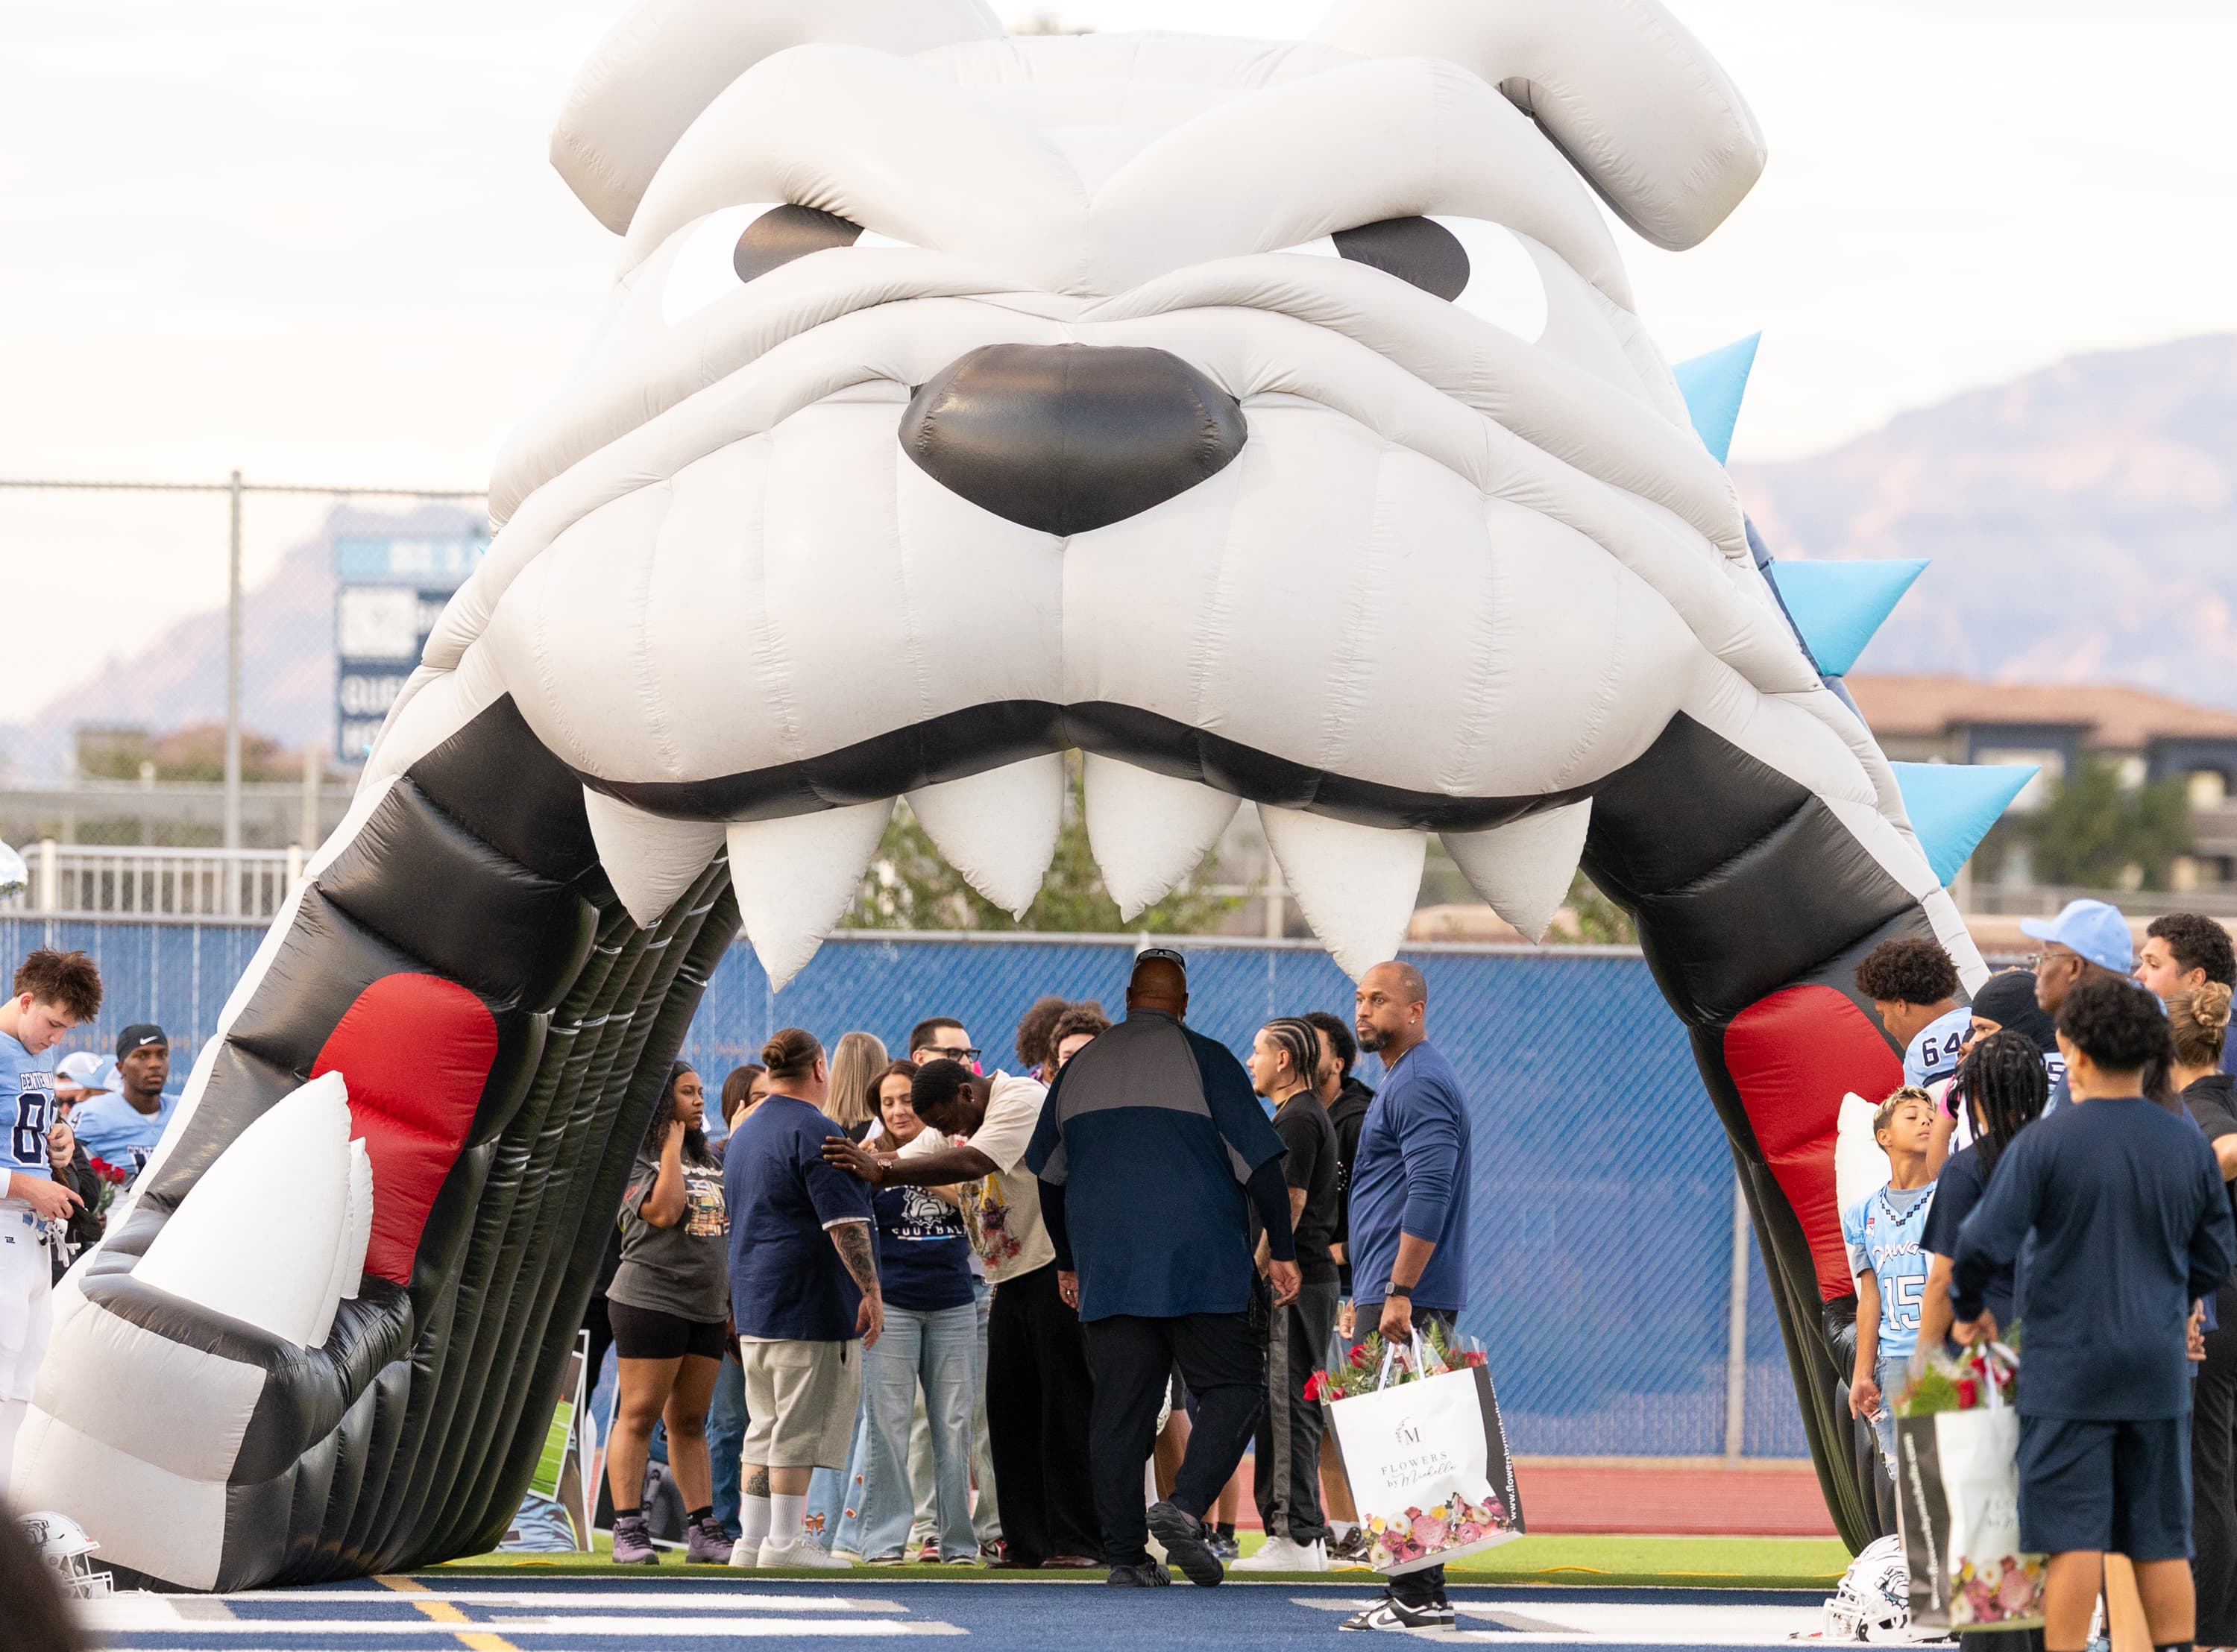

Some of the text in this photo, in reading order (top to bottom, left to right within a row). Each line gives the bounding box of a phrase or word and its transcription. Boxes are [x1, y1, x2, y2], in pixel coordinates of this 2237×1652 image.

[1922, 1031, 1963, 1068] 64
[1884, 1274, 1927, 1331] 15
[1403, 1427, 1420, 1446] M
[1381, 1450, 1448, 1476] FLOWERS
[1387, 1479, 1398, 1489] by
